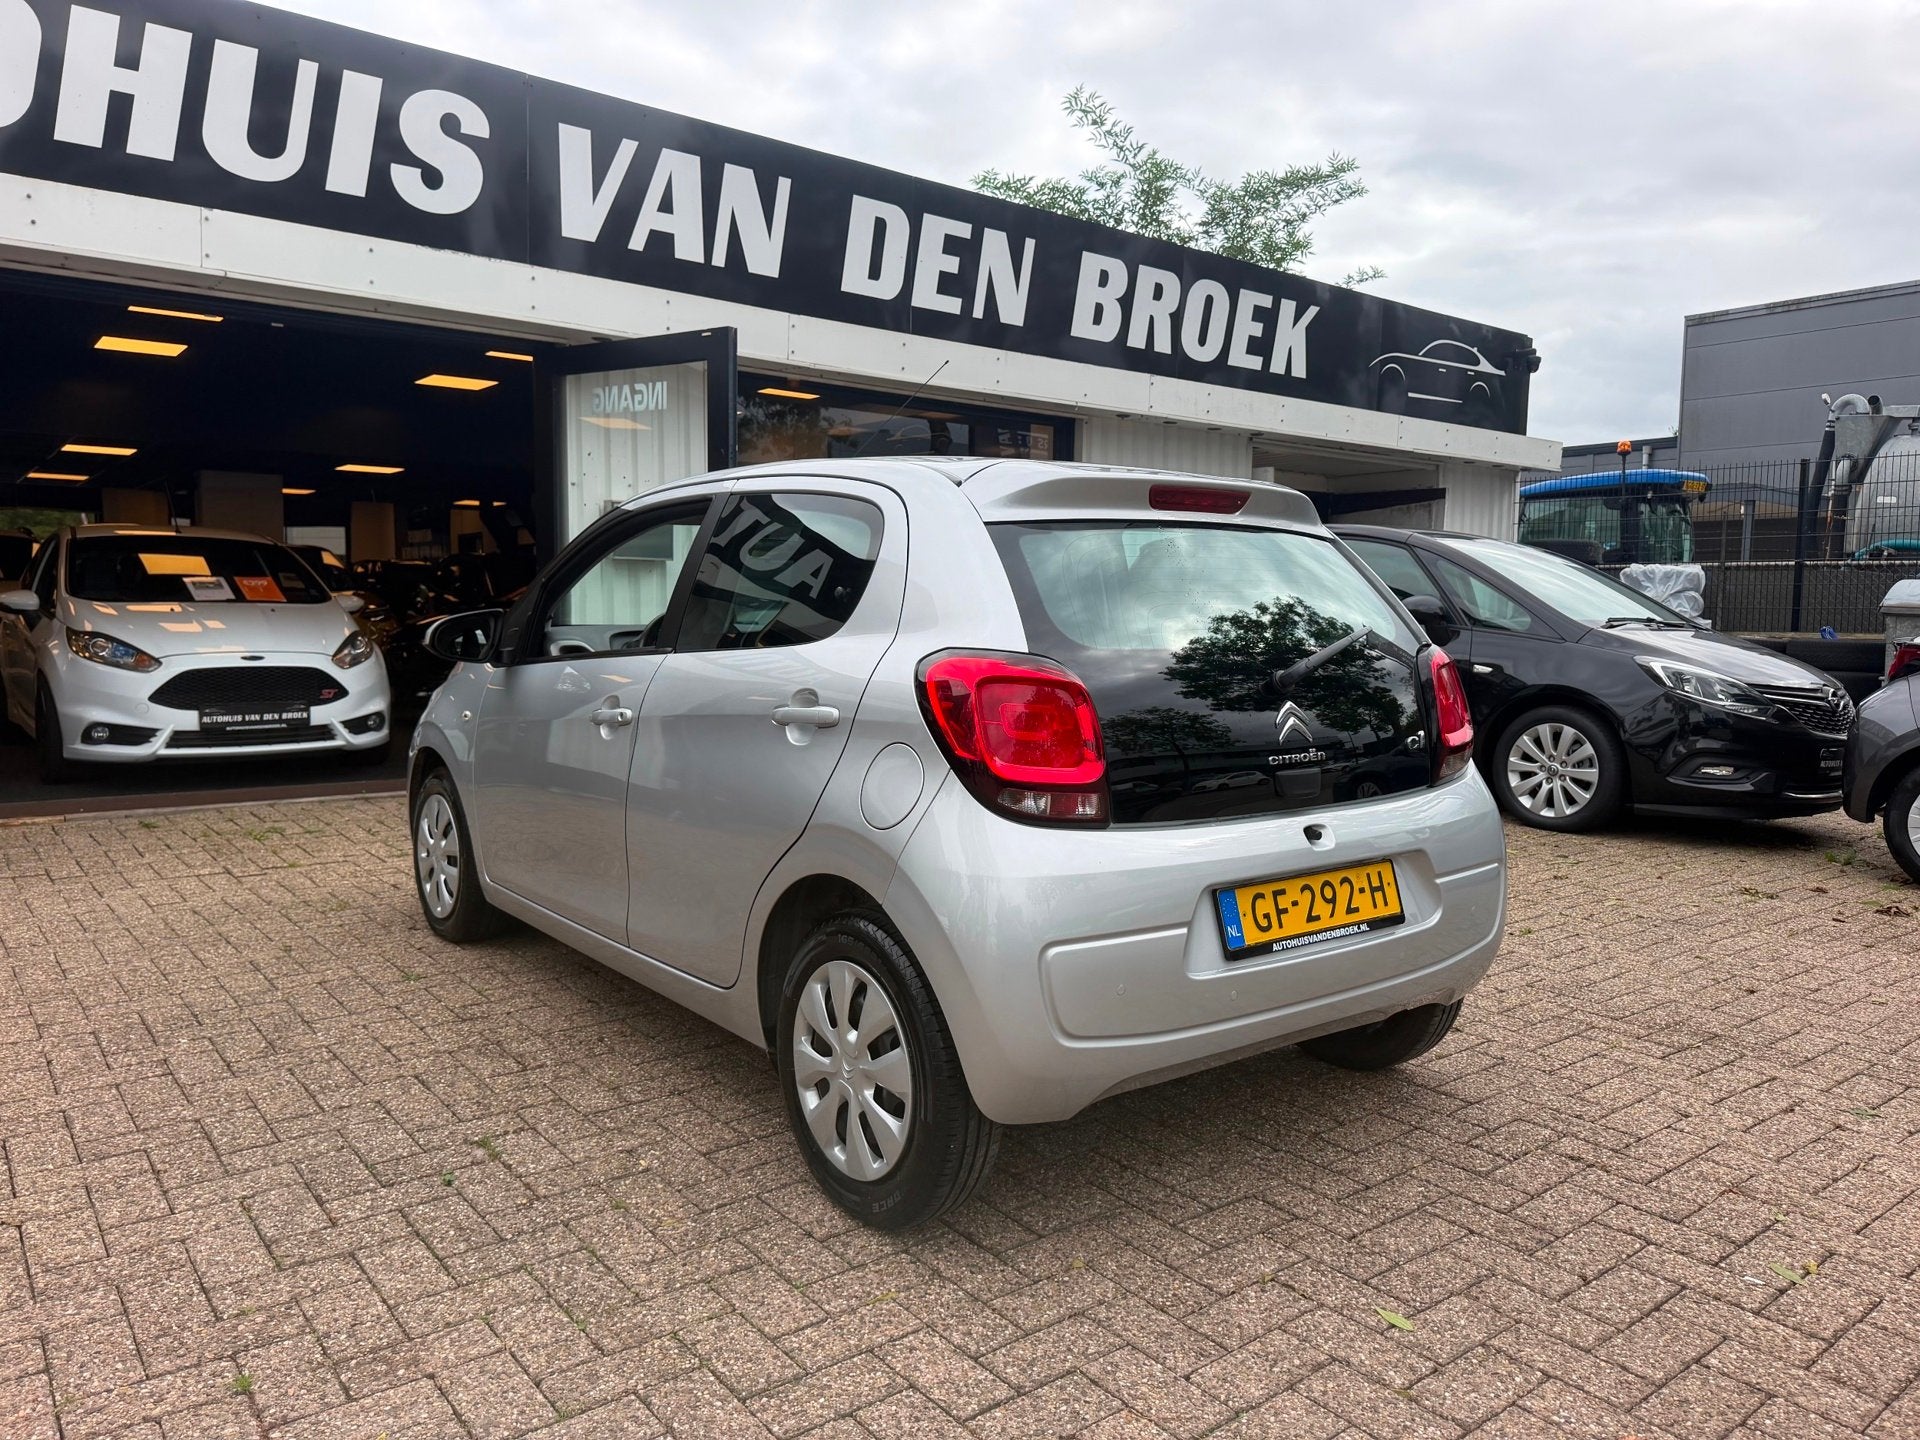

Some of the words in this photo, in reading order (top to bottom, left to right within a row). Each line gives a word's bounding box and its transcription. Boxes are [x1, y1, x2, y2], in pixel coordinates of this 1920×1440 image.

[558, 122, 791, 278] VAN
[841, 194, 1035, 326] DEN
[1070, 251, 1320, 378] BROEK
[201, 714, 243, 723] AUTOHUIS
[245, 713, 261, 721] VAN
[281, 711, 308, 719] BROEK
[1251, 870, 1388, 933] GF-292-H
[1227, 925, 1241, 938] NL
[1272, 923, 1370, 952] AUTOHUISVANDENBROEK.NL
